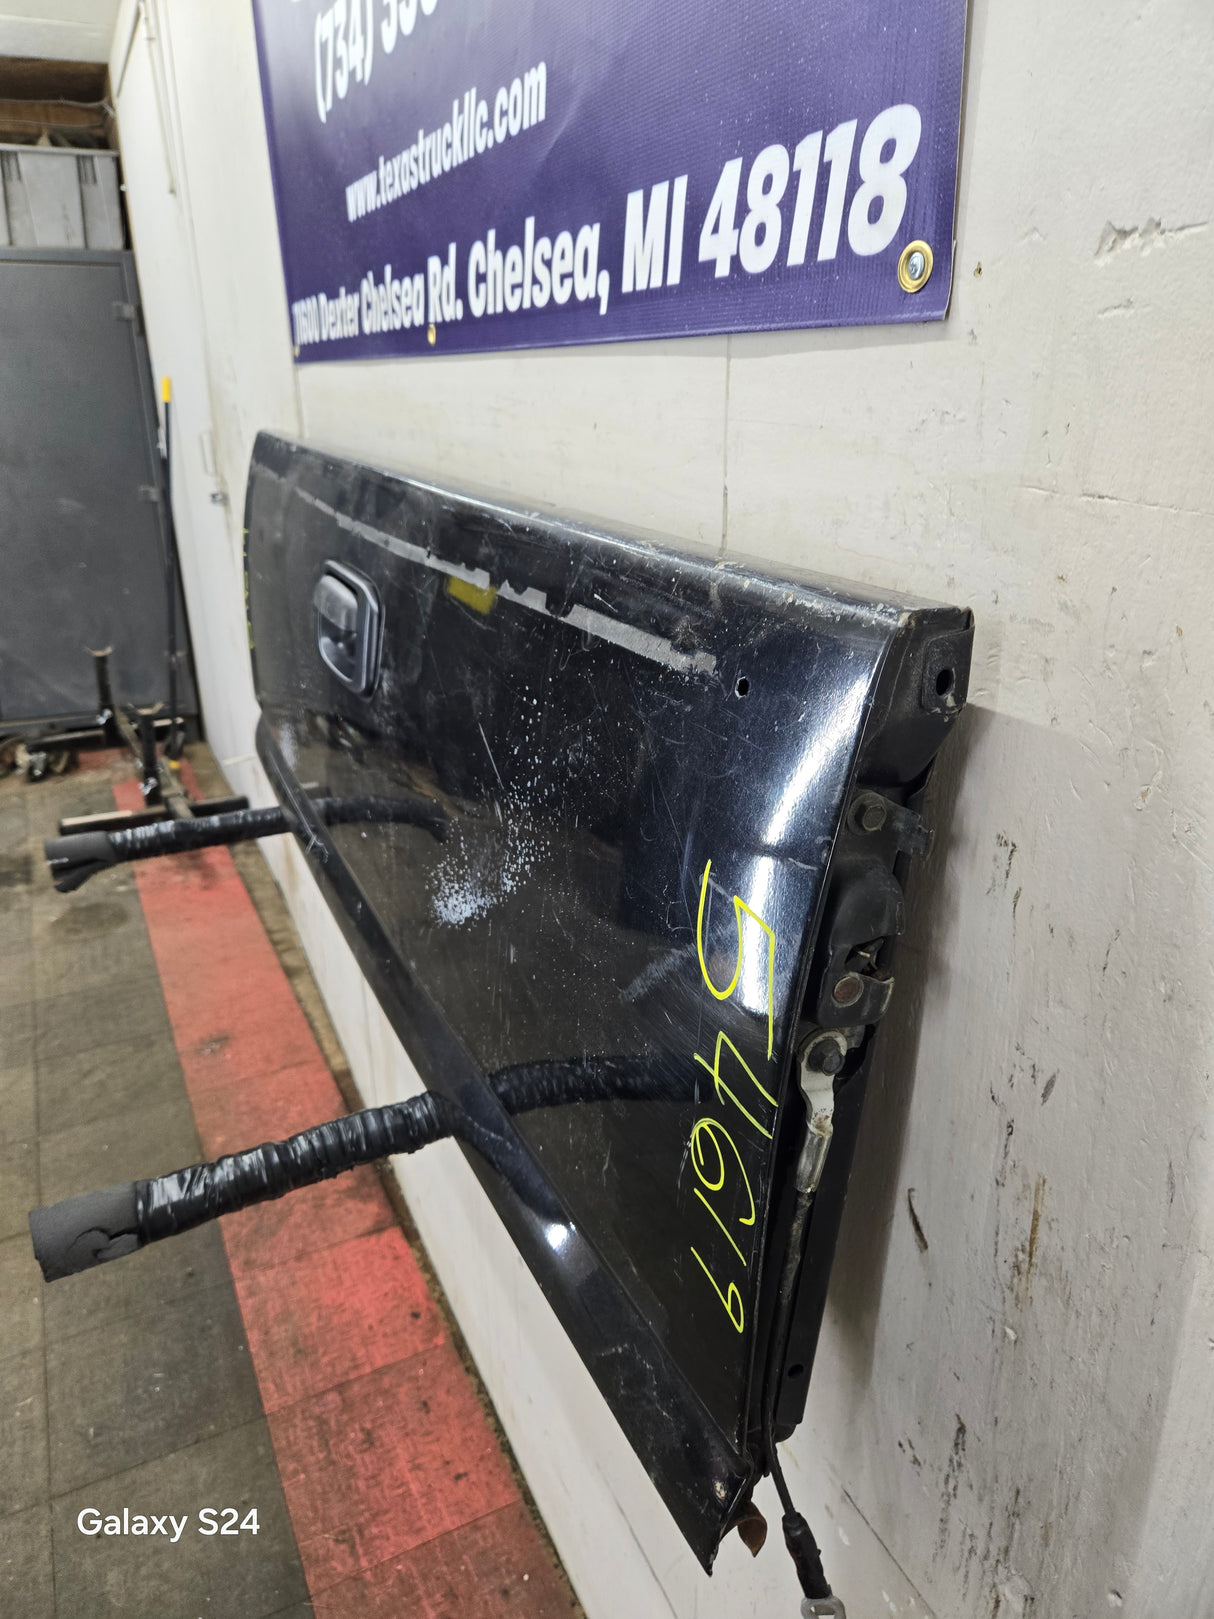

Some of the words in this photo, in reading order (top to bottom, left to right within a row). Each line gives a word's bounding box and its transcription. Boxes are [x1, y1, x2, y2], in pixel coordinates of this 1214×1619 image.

[314, 0, 374, 123] (734)
[345, 61, 548, 223] www.texastruckllc.com
[317, 286, 360, 341] Dexter
[360, 263, 426, 335] Chelsea
[427, 242, 464, 324] Rd.
[468, 216, 610, 316] Chelsea,
[621, 174, 689, 294] MI
[698, 103, 923, 279] 48118
